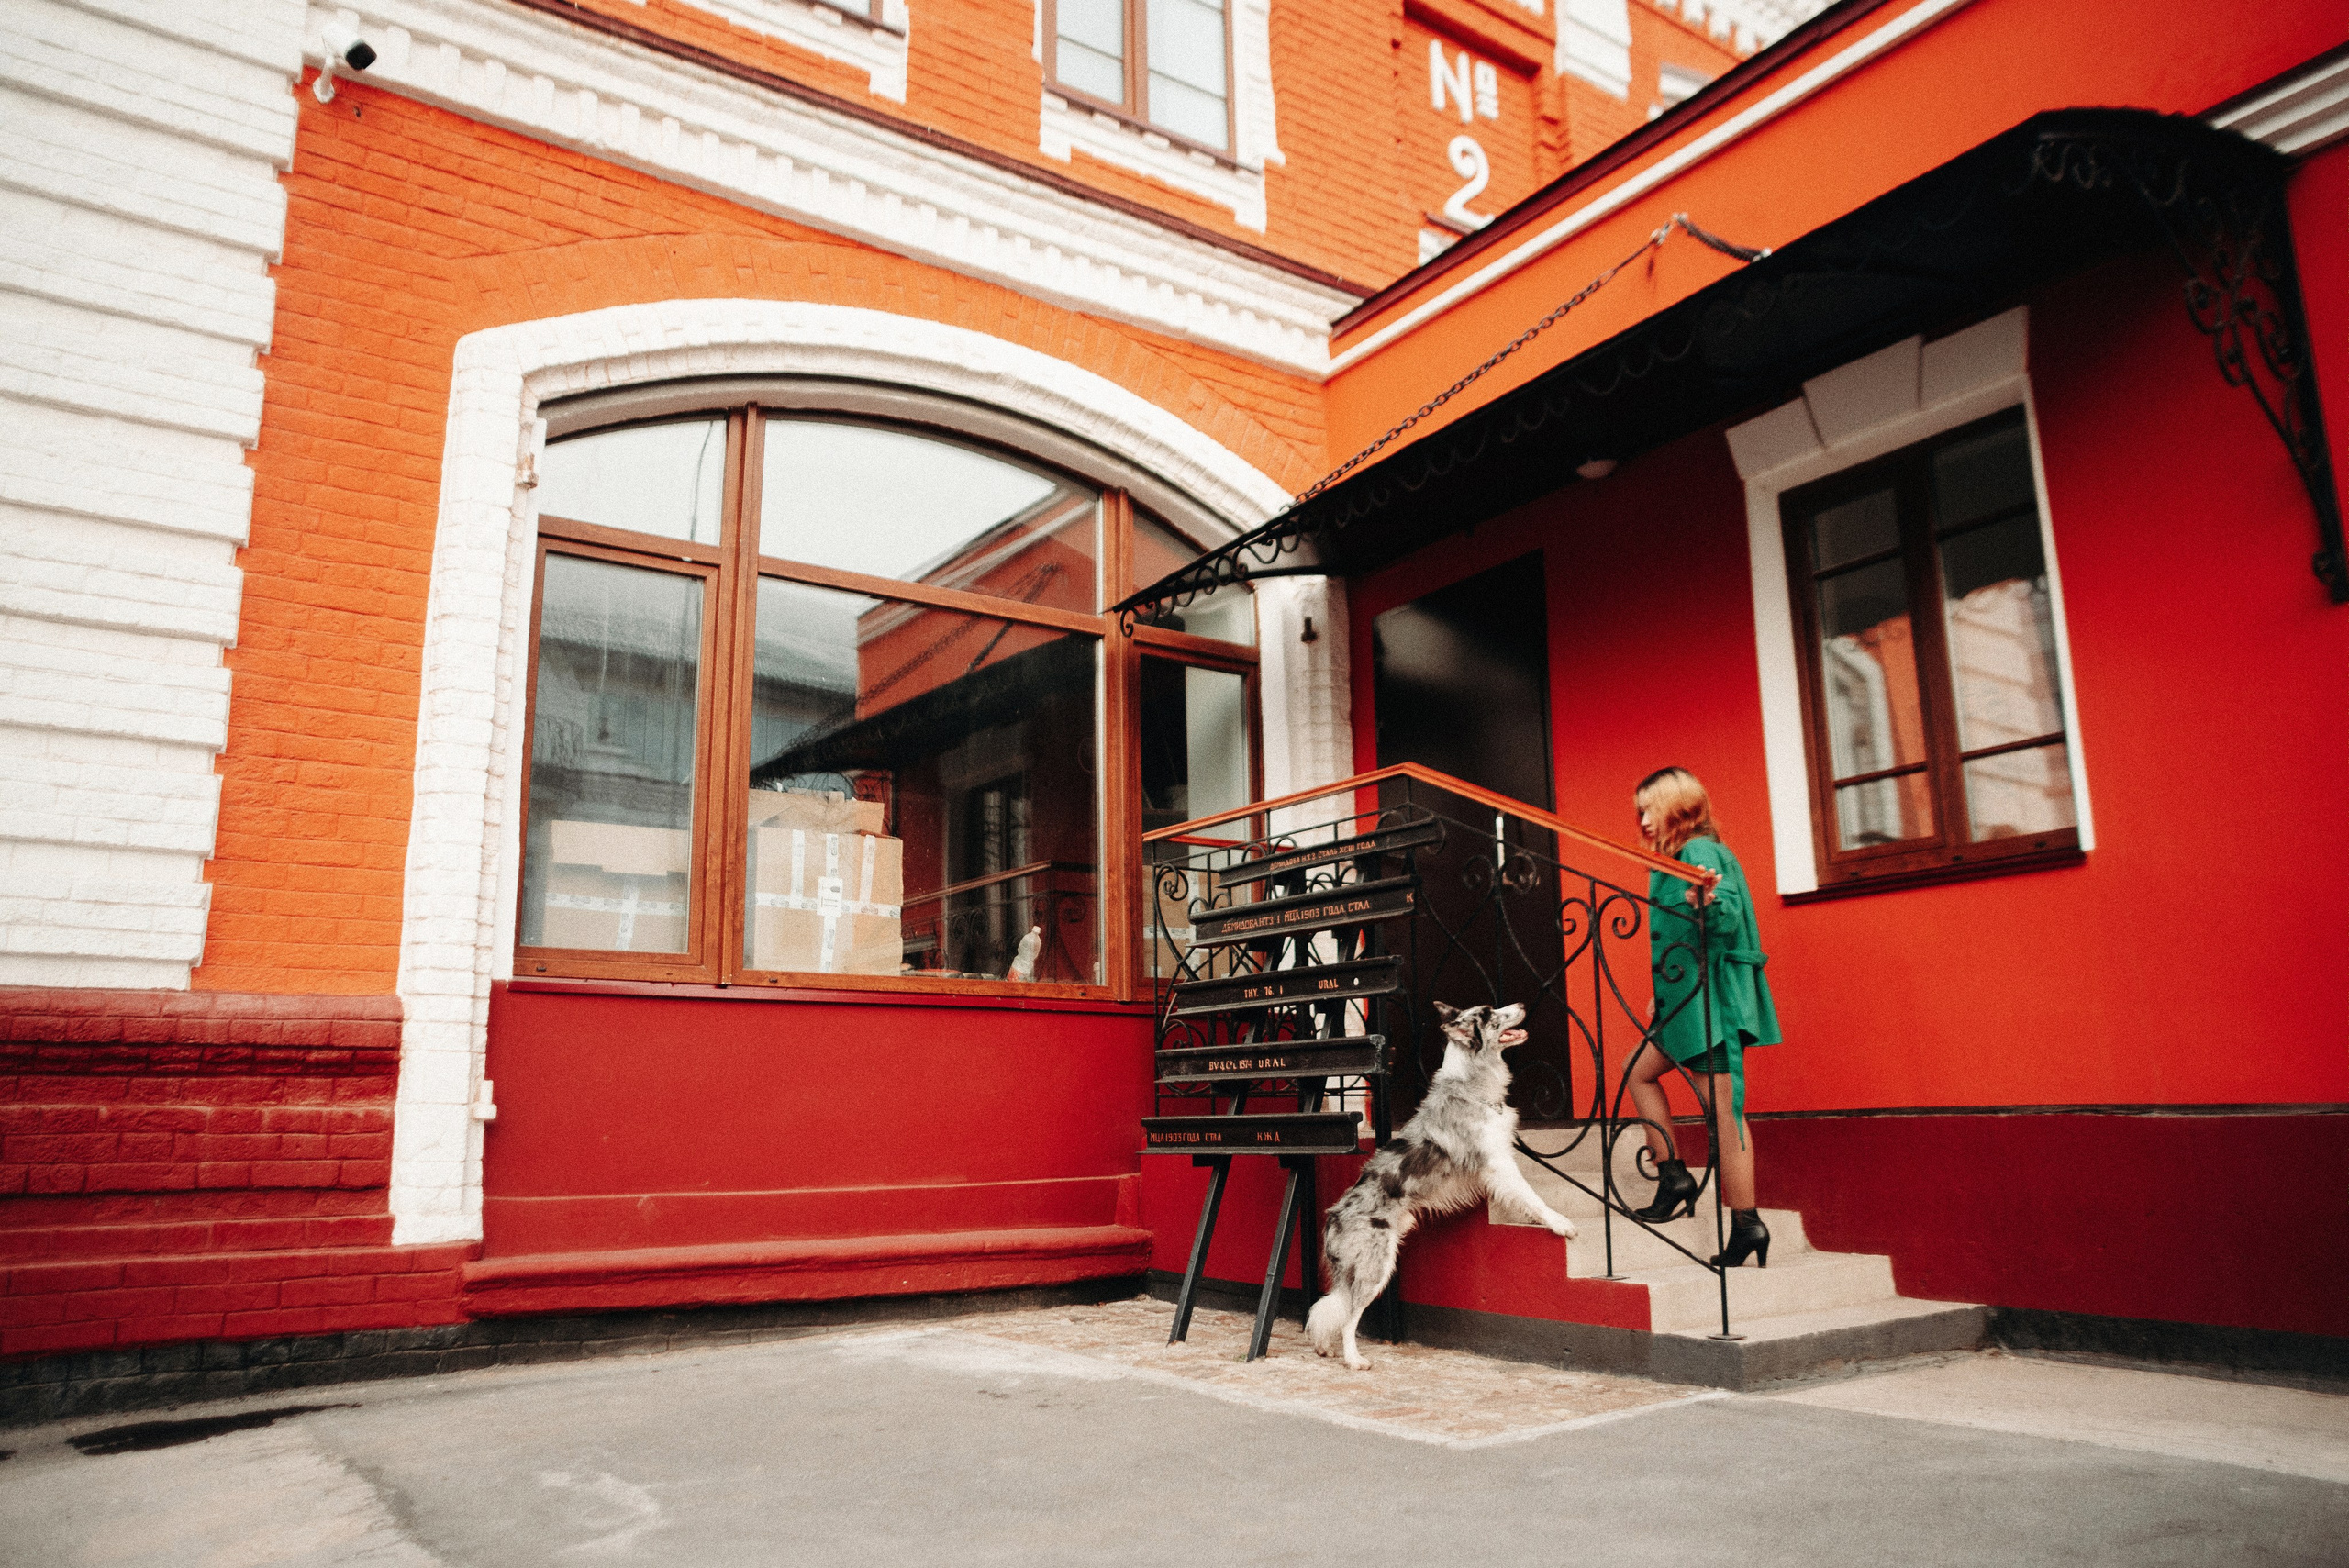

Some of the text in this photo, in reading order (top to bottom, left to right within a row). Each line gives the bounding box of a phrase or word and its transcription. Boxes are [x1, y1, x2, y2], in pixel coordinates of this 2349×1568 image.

[1443, 135, 1497, 230] 2
[1356, 840, 1376, 851] ГОДА
[1323, 904, 1345, 917] ГОДА
[1348, 899, 1370, 912] СТАЛ
[1318, 978, 1339, 989] URAL
[1258, 1058, 1286, 1068] URAL
